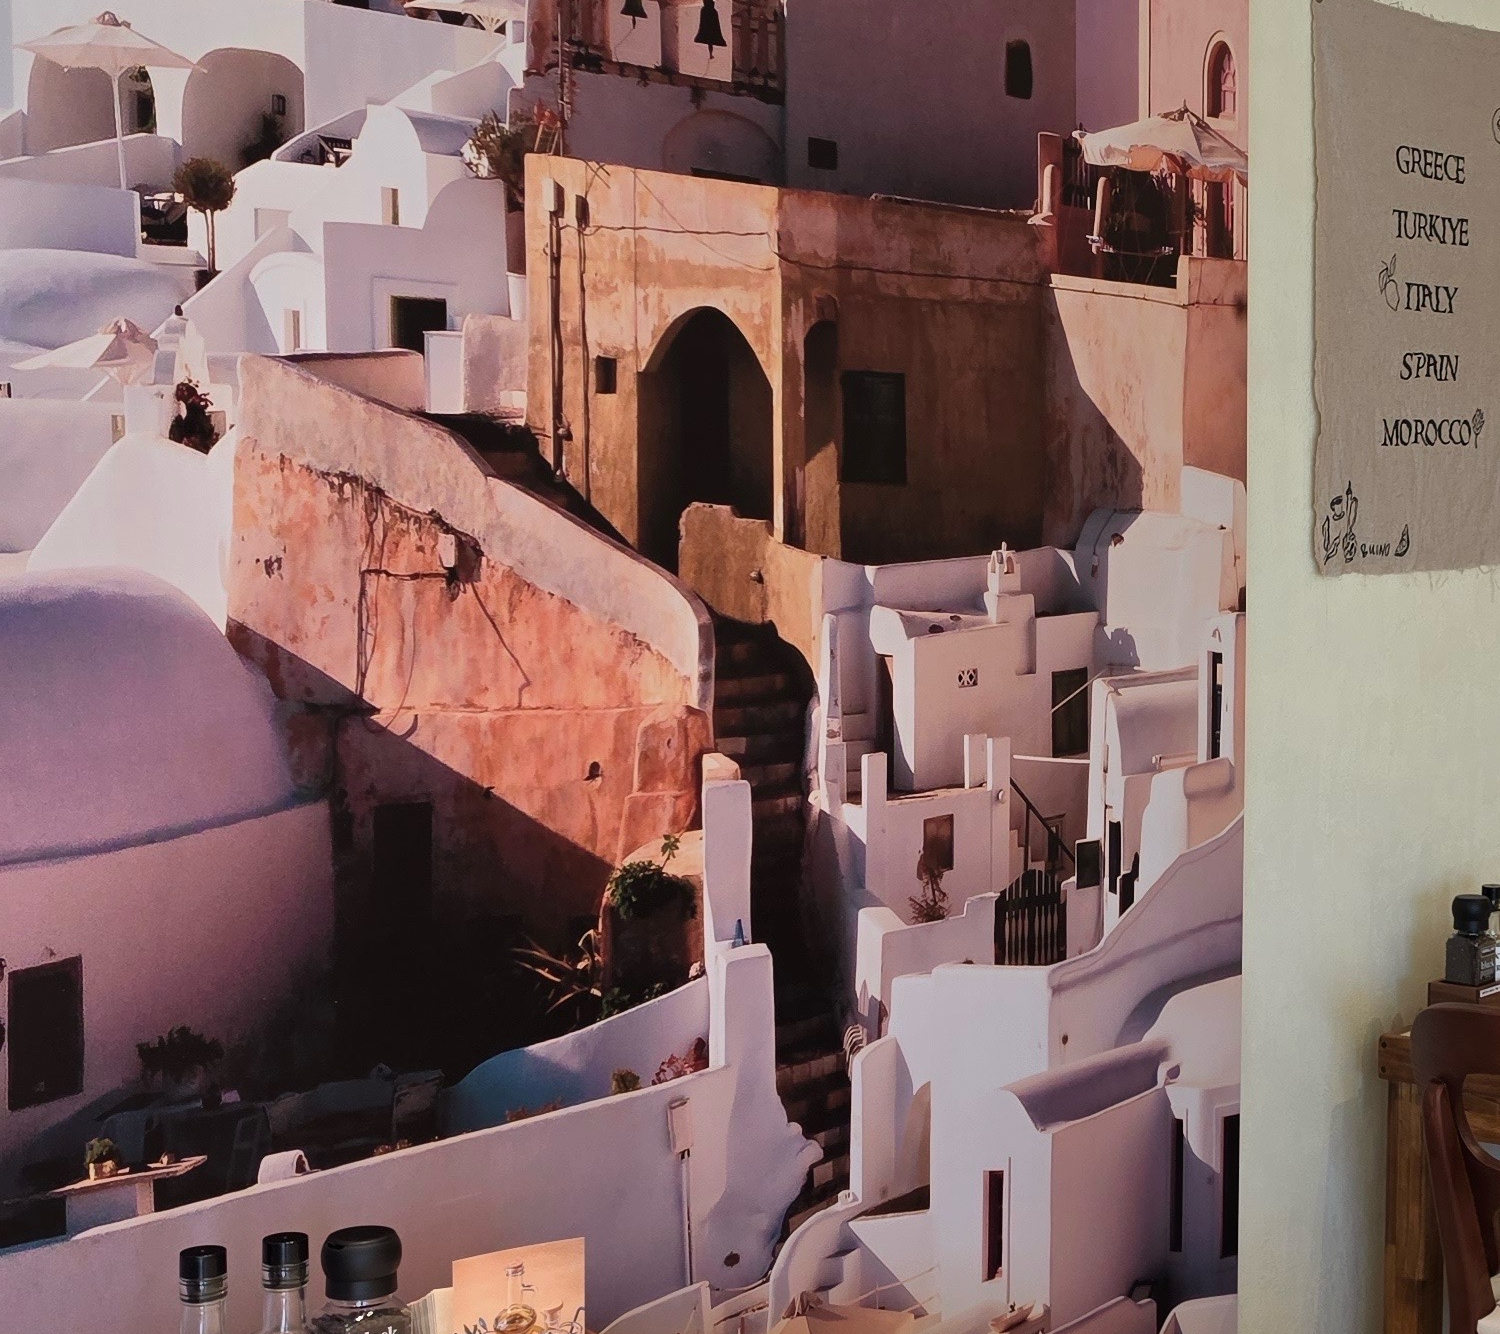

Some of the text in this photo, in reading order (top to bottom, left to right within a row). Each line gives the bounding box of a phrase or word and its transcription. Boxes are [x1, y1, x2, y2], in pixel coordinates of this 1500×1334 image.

[1395, 145, 1466, 184] GREECE
[1392, 209, 1470, 247] TURKIYE
[1404, 281, 1459, 314] ITALY
[1399, 352, 1459, 381] SPAIN
[1381, 418, 1472, 447] MOROCCO
